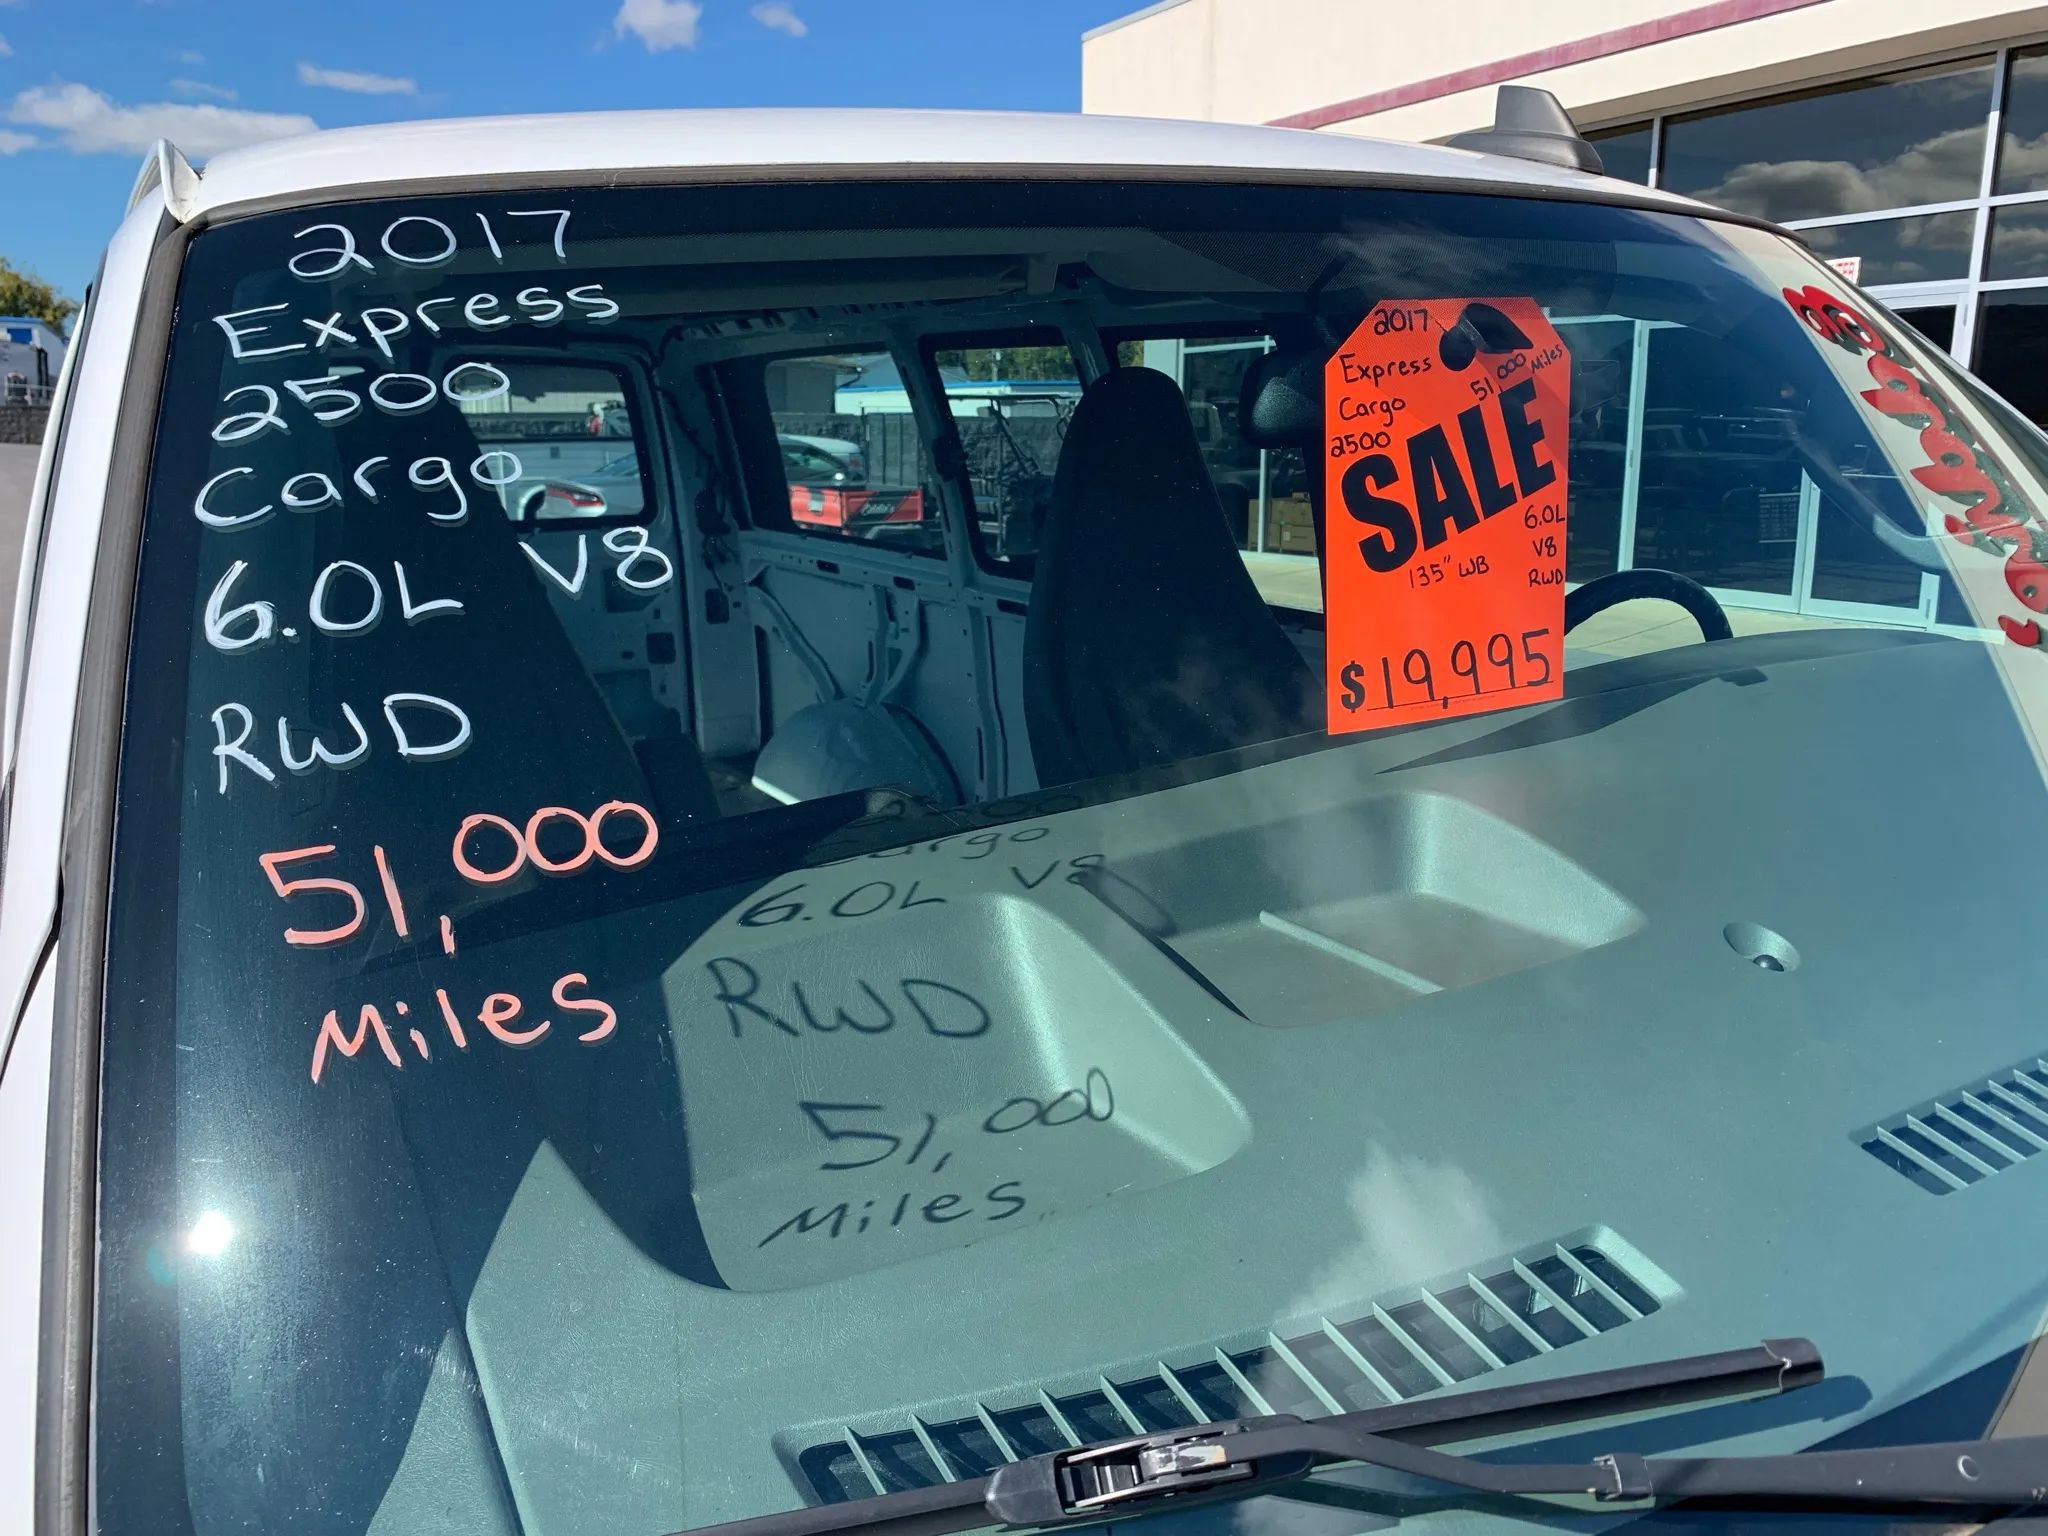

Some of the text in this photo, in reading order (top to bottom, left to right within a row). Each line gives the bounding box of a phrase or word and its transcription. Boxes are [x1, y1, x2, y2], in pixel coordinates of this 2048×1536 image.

[288, 210, 572, 277] 2017
[211, 284, 620, 359] Express
[1373, 308, 1429, 336] 2017
[1338, 352, 1432, 388] Express
[1530, 344, 1563, 374] Miles
[211, 361, 511, 441] 2500
[1338, 396, 1407, 427] Cargo
[1330, 430, 1392, 458] 2500
[1341, 376, 1557, 574] SALE
[194, 450, 523, 525] Cargo
[1523, 504, 1566, 530] 6.0L
[1409, 555, 1490, 589] 135" WB
[1528, 568, 1564, 588] RWD
[1532, 535, 1558, 558] V8
[204, 526, 674, 650] 6.0L V8
[1340, 628, 1551, 714] $19,995
[211, 692, 472, 795] RWD
[259, 799, 659, 956] 51,000
[736, 880, 947, 927] 6.0L
[311, 973, 617, 1085] Miles
[706, 956, 992, 1039] RWD
[799, 1066, 1115, 1174] 51,000
[757, 1180, 1027, 1249] Miles
